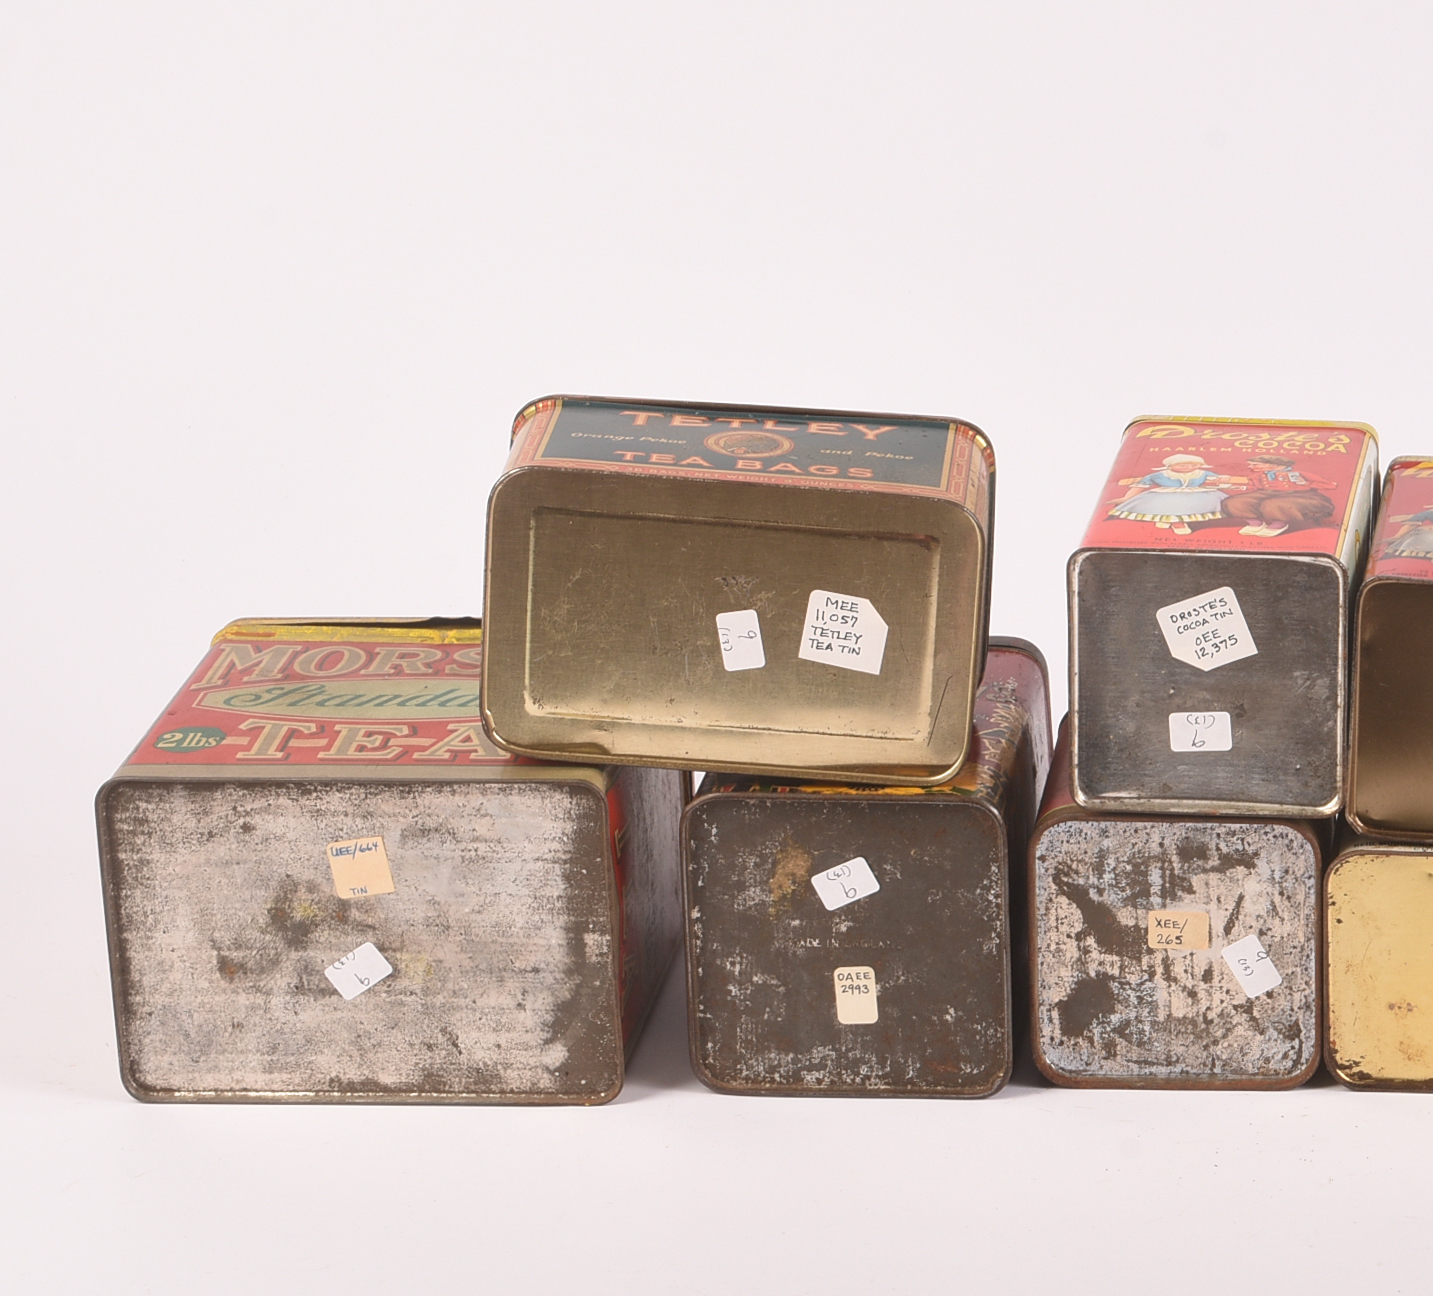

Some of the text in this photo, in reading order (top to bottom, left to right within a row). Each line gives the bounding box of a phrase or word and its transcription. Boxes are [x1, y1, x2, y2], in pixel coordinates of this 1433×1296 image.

[620, 411, 901, 440] TETLEY
[571, 432, 687, 445] Orange Pekoe
[1135, 424, 1351, 445] Droste's
[865, 451, 914, 460] Pekoe
[1234, 440, 1347, 454] COCOA
[1242, 448, 1328, 456] HOLLAND
[613, 451, 874, 478] TEA BAGS
[726, 474, 778, 482] WEIGHT
[826, 597, 859, 613] MEE
[1169, 597, 1228, 623] DROSTE'S
[816, 609, 858, 627] 11,057
[1177, 608, 1234, 634] COCOA TIN
[811, 625, 863, 645] TETLEY
[1195, 628, 1221, 646] OEE
[809, 638, 861, 656] TEA TIN
[1194, 634, 1239, 660] 12,375
[192, 644, 483, 690] MORS
[223, 684, 480, 708] Standa
[158, 732, 221, 748] 2 lbs
[350, 886, 367, 896] TIN
[1154, 917, 1188, 934] XEE/
[827, 938, 839, 948] IN
[1157, 934, 1184, 945] 265
[837, 972, 872, 982] OAEE
[841, 984, 870, 995] 2993
